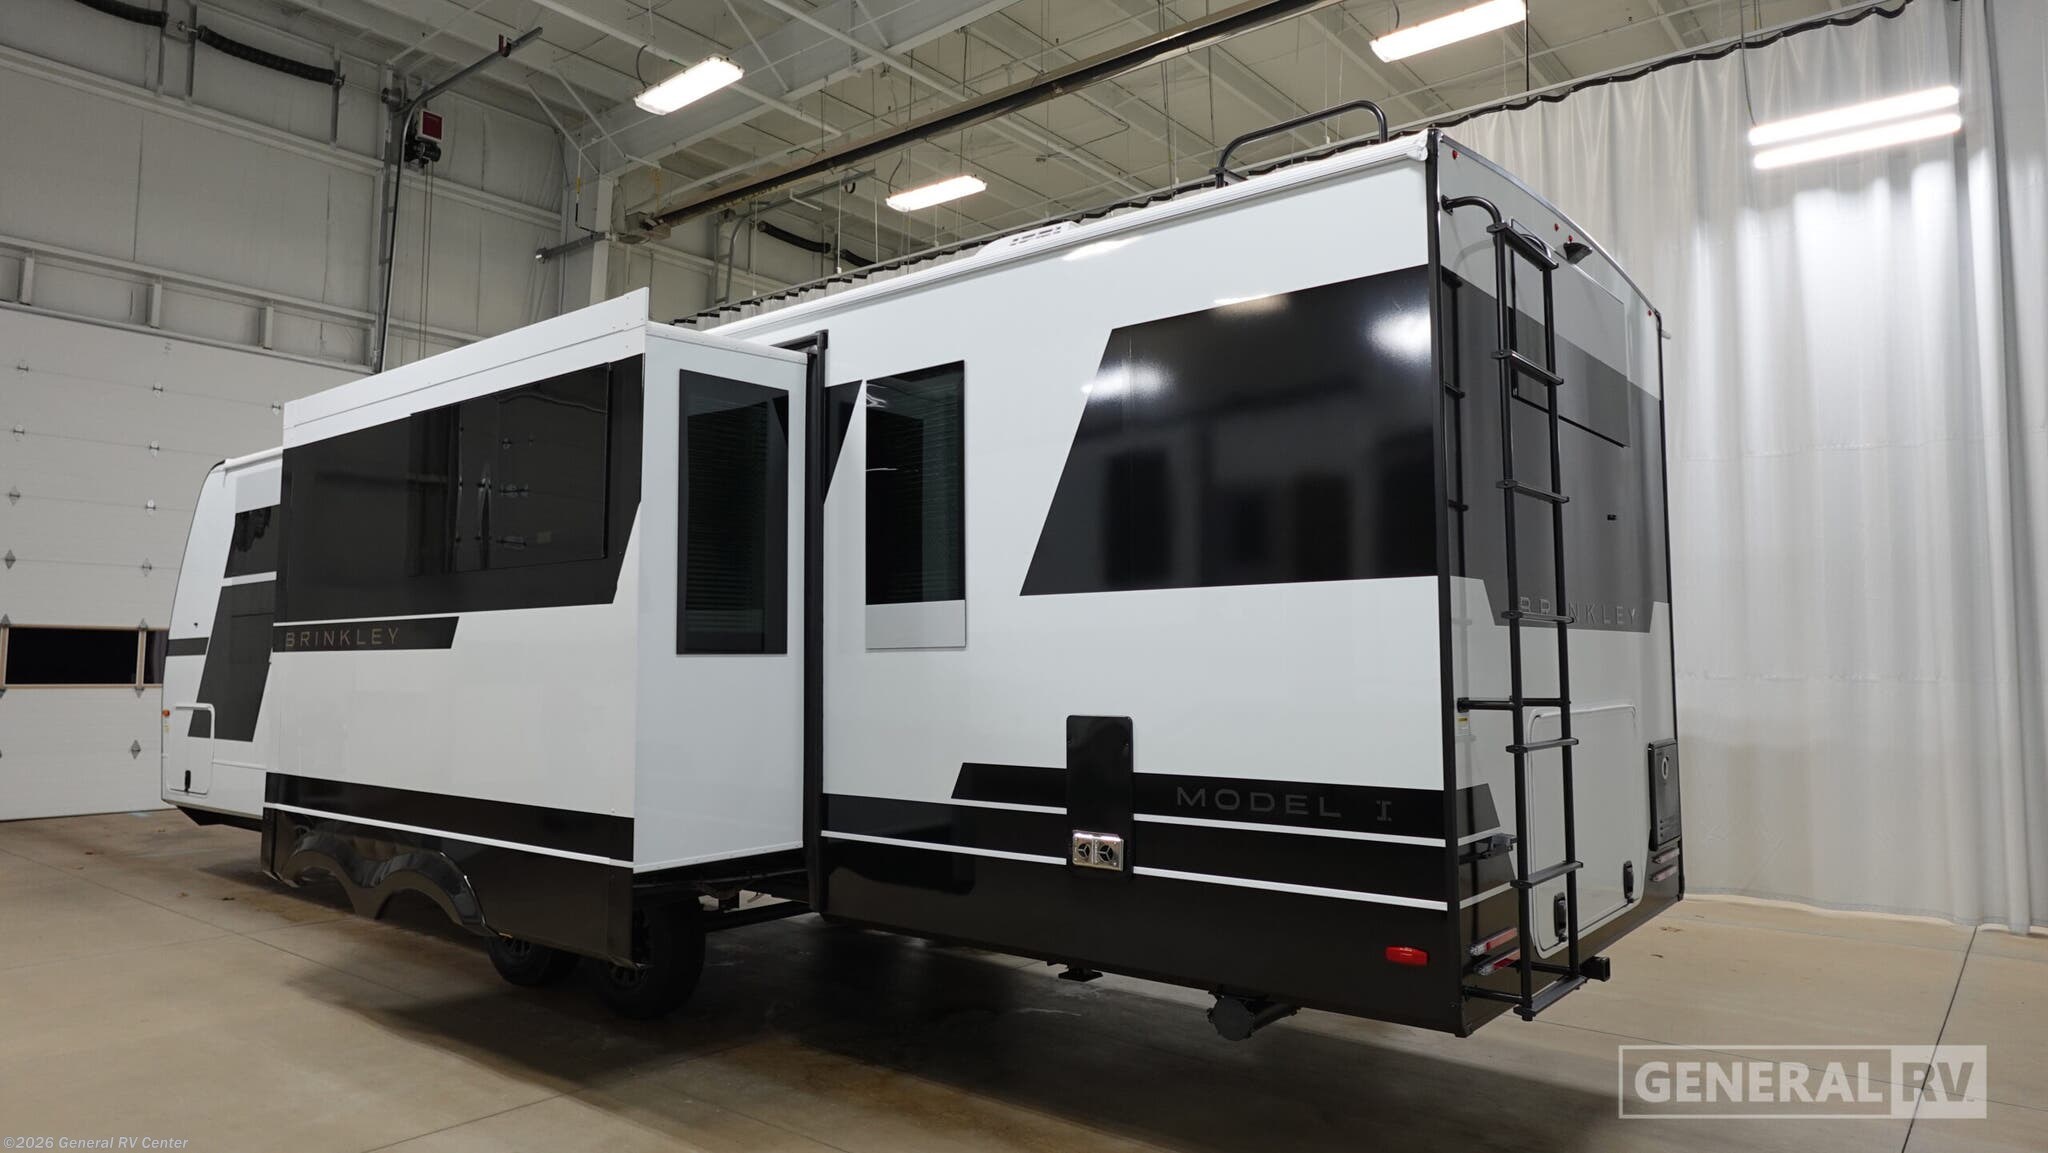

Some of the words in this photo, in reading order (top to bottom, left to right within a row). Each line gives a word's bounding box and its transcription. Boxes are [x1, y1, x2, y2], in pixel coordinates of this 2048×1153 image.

[1519, 596, 1636, 625] BRNKLEY
[285, 627, 399, 647] BRINKLEY
[1176, 786, 1342, 818] MODEL
[1376, 799, 1393, 822] I
